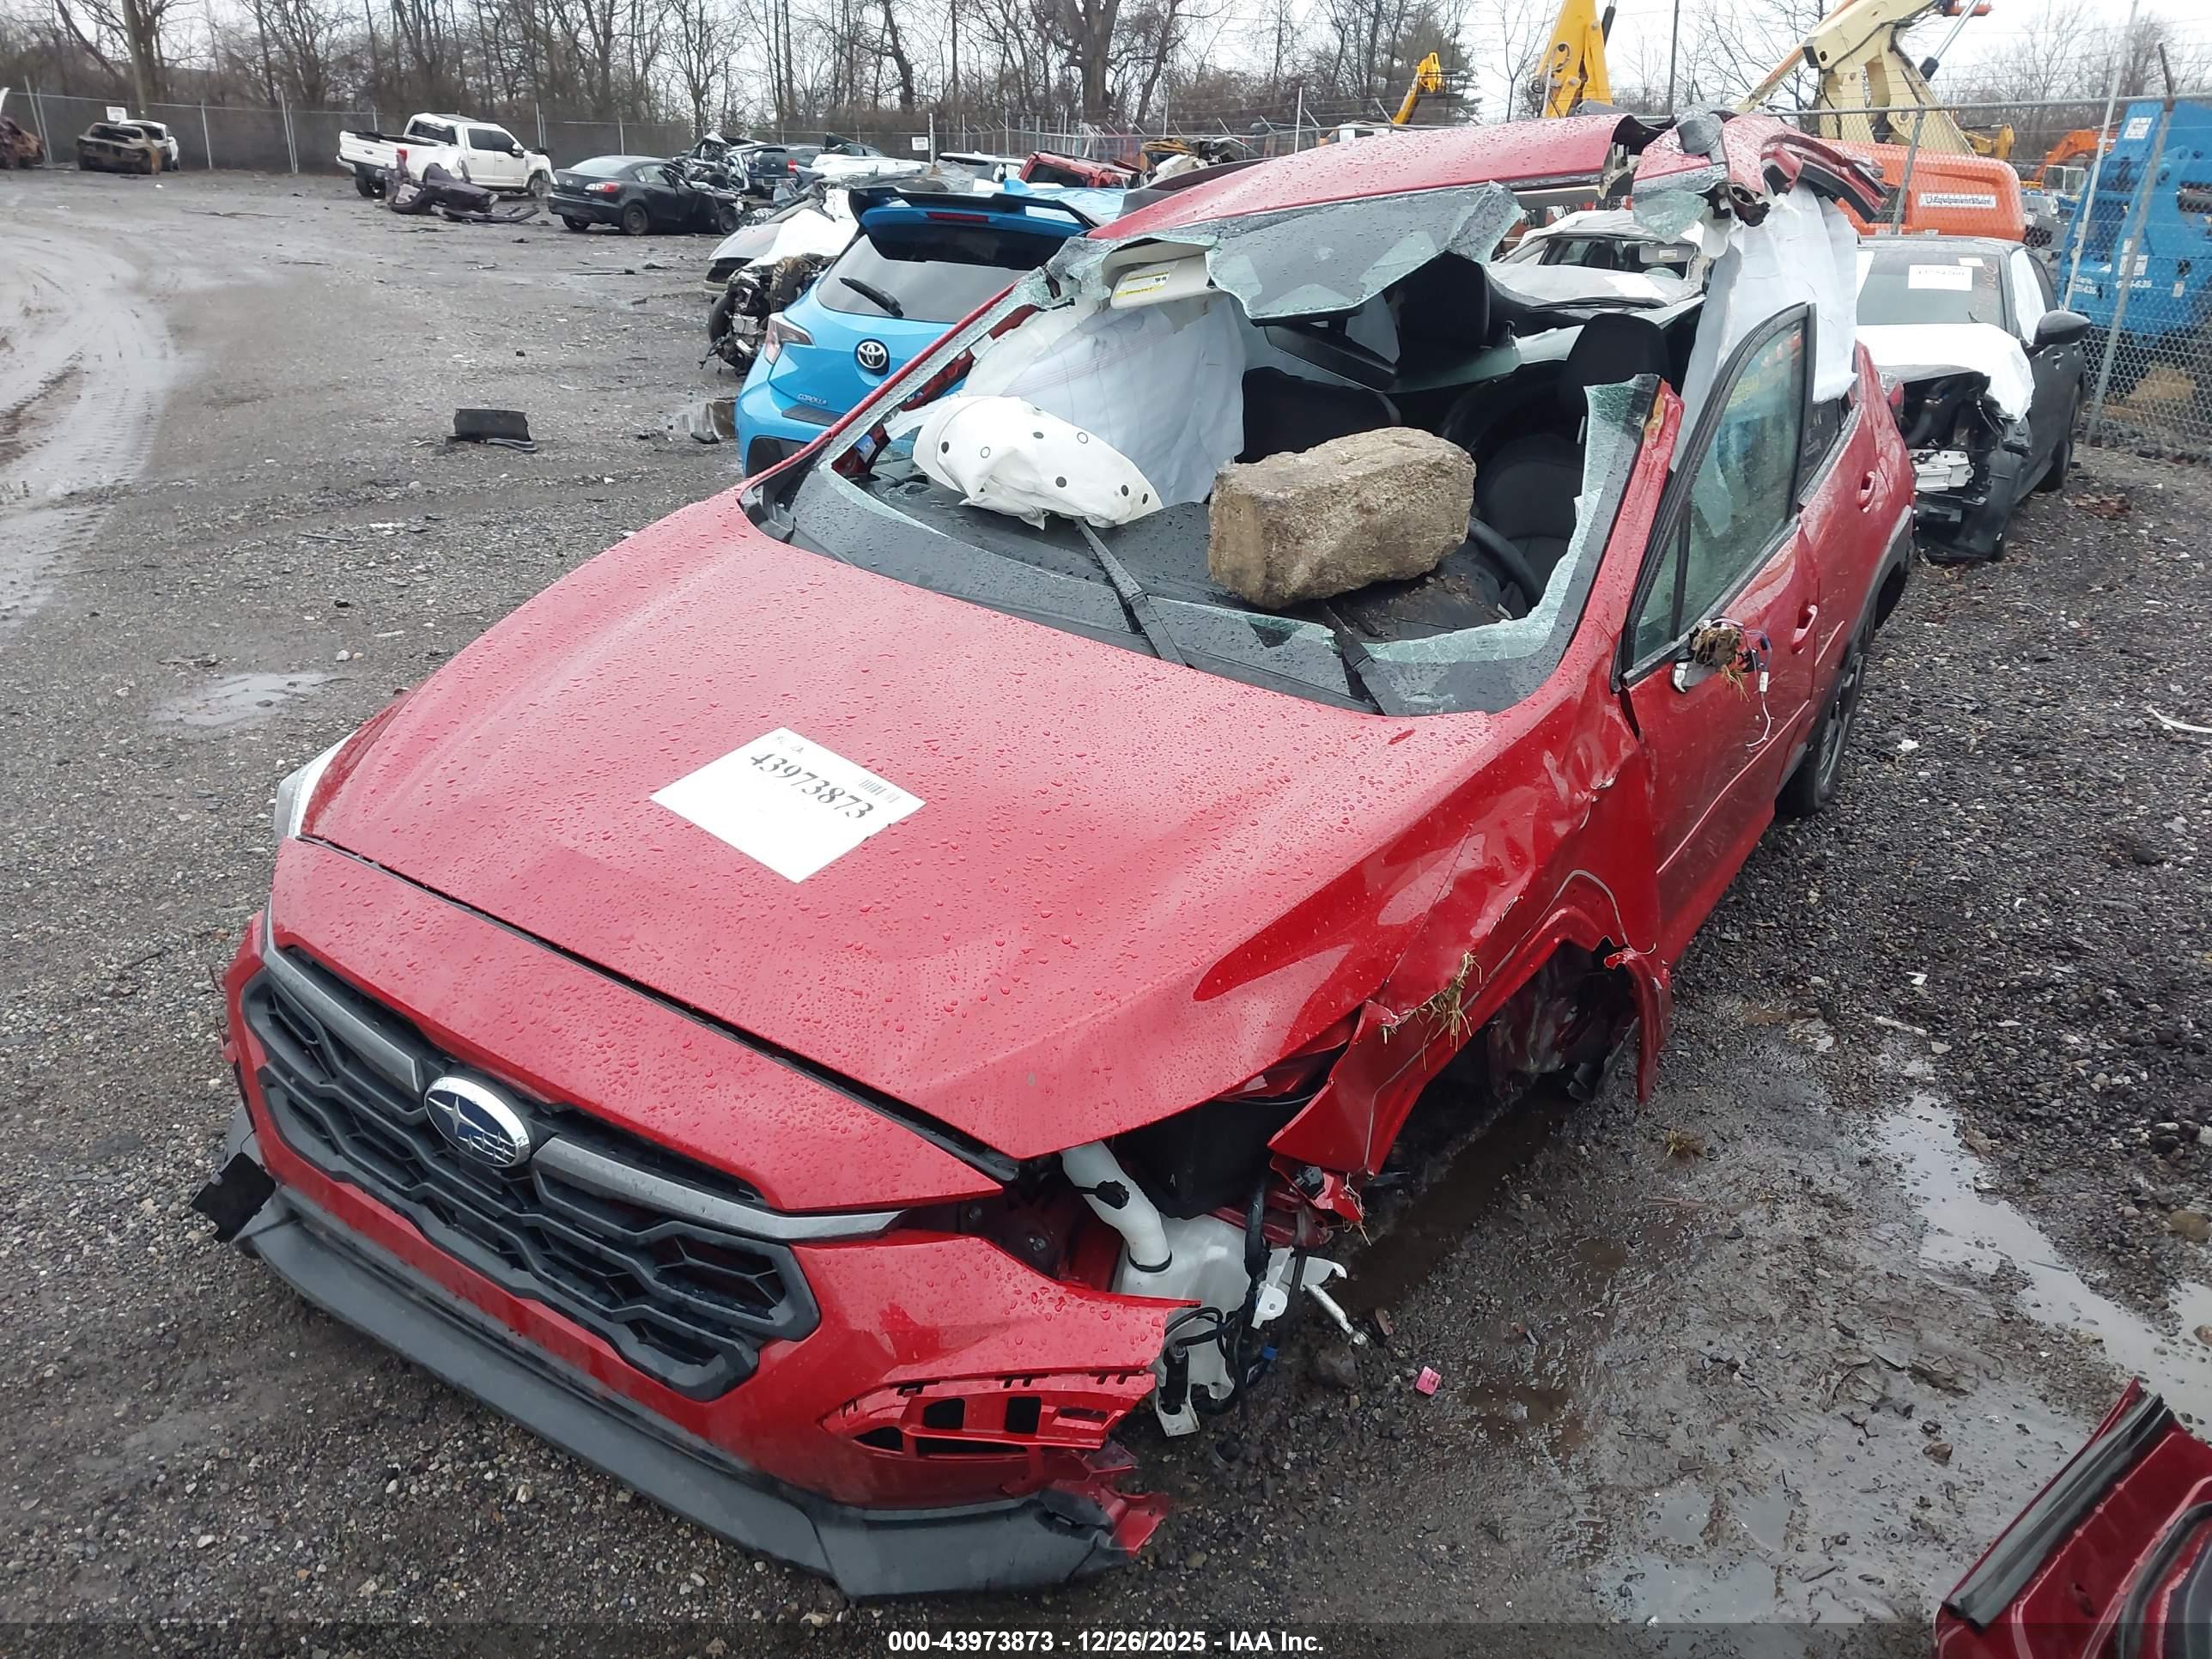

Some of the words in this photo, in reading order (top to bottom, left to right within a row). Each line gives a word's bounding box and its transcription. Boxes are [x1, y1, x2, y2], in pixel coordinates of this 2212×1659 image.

[1932, 195, 1992, 205] EquipmentShare
[798, 393, 828, 405] COROLLA
[750, 753, 874, 818] 43973873
